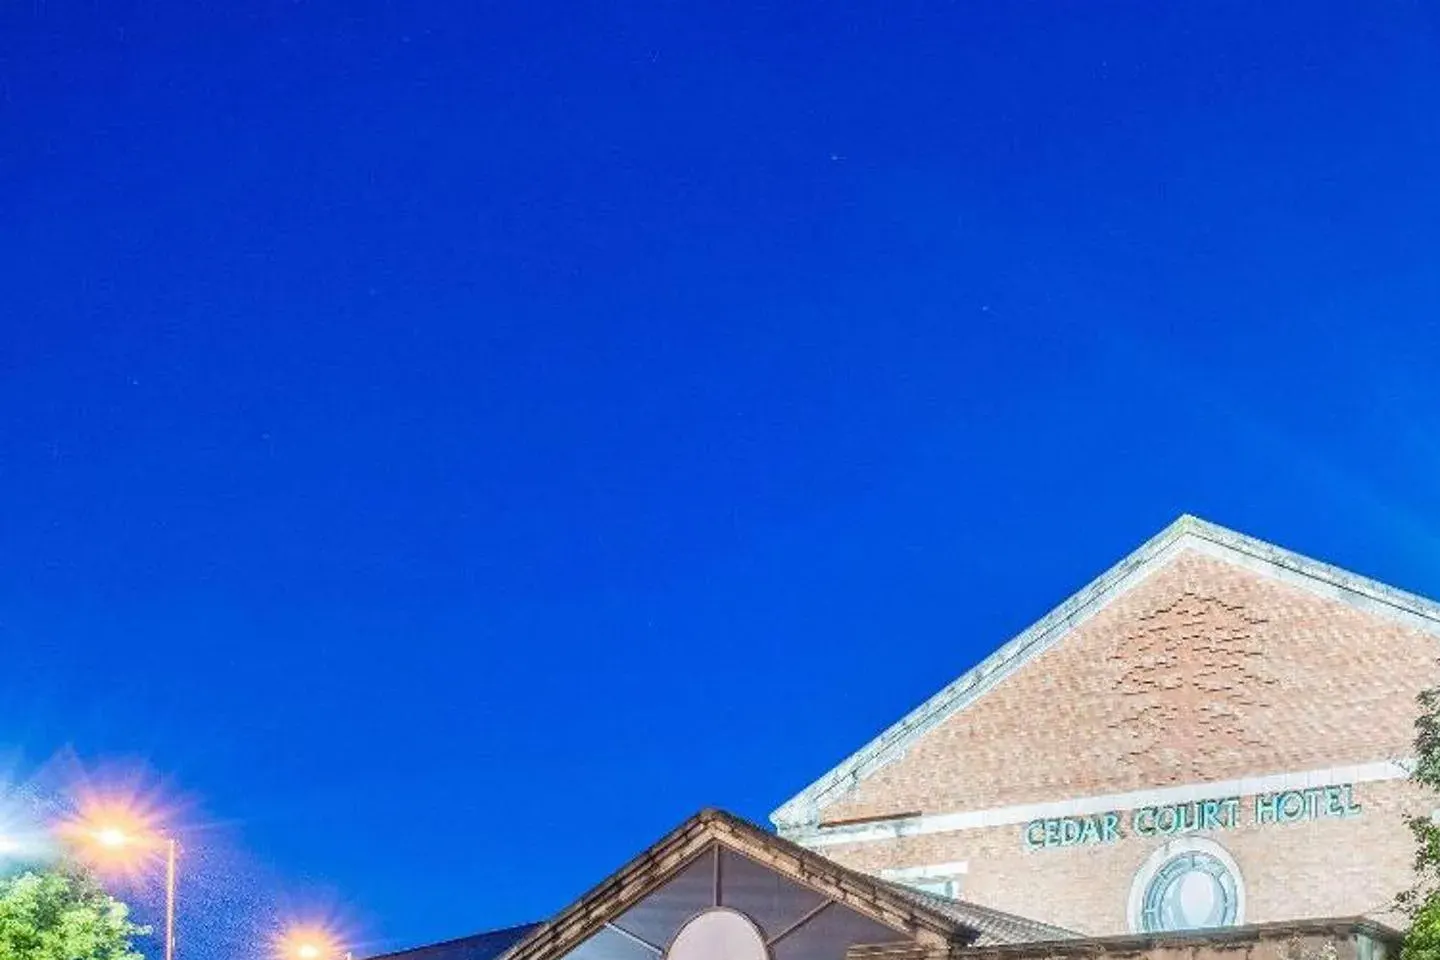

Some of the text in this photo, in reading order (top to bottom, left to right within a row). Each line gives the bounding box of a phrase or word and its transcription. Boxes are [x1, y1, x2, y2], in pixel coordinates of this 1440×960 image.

[1025, 783, 1362, 849] CEDAR COURT HOTEL
